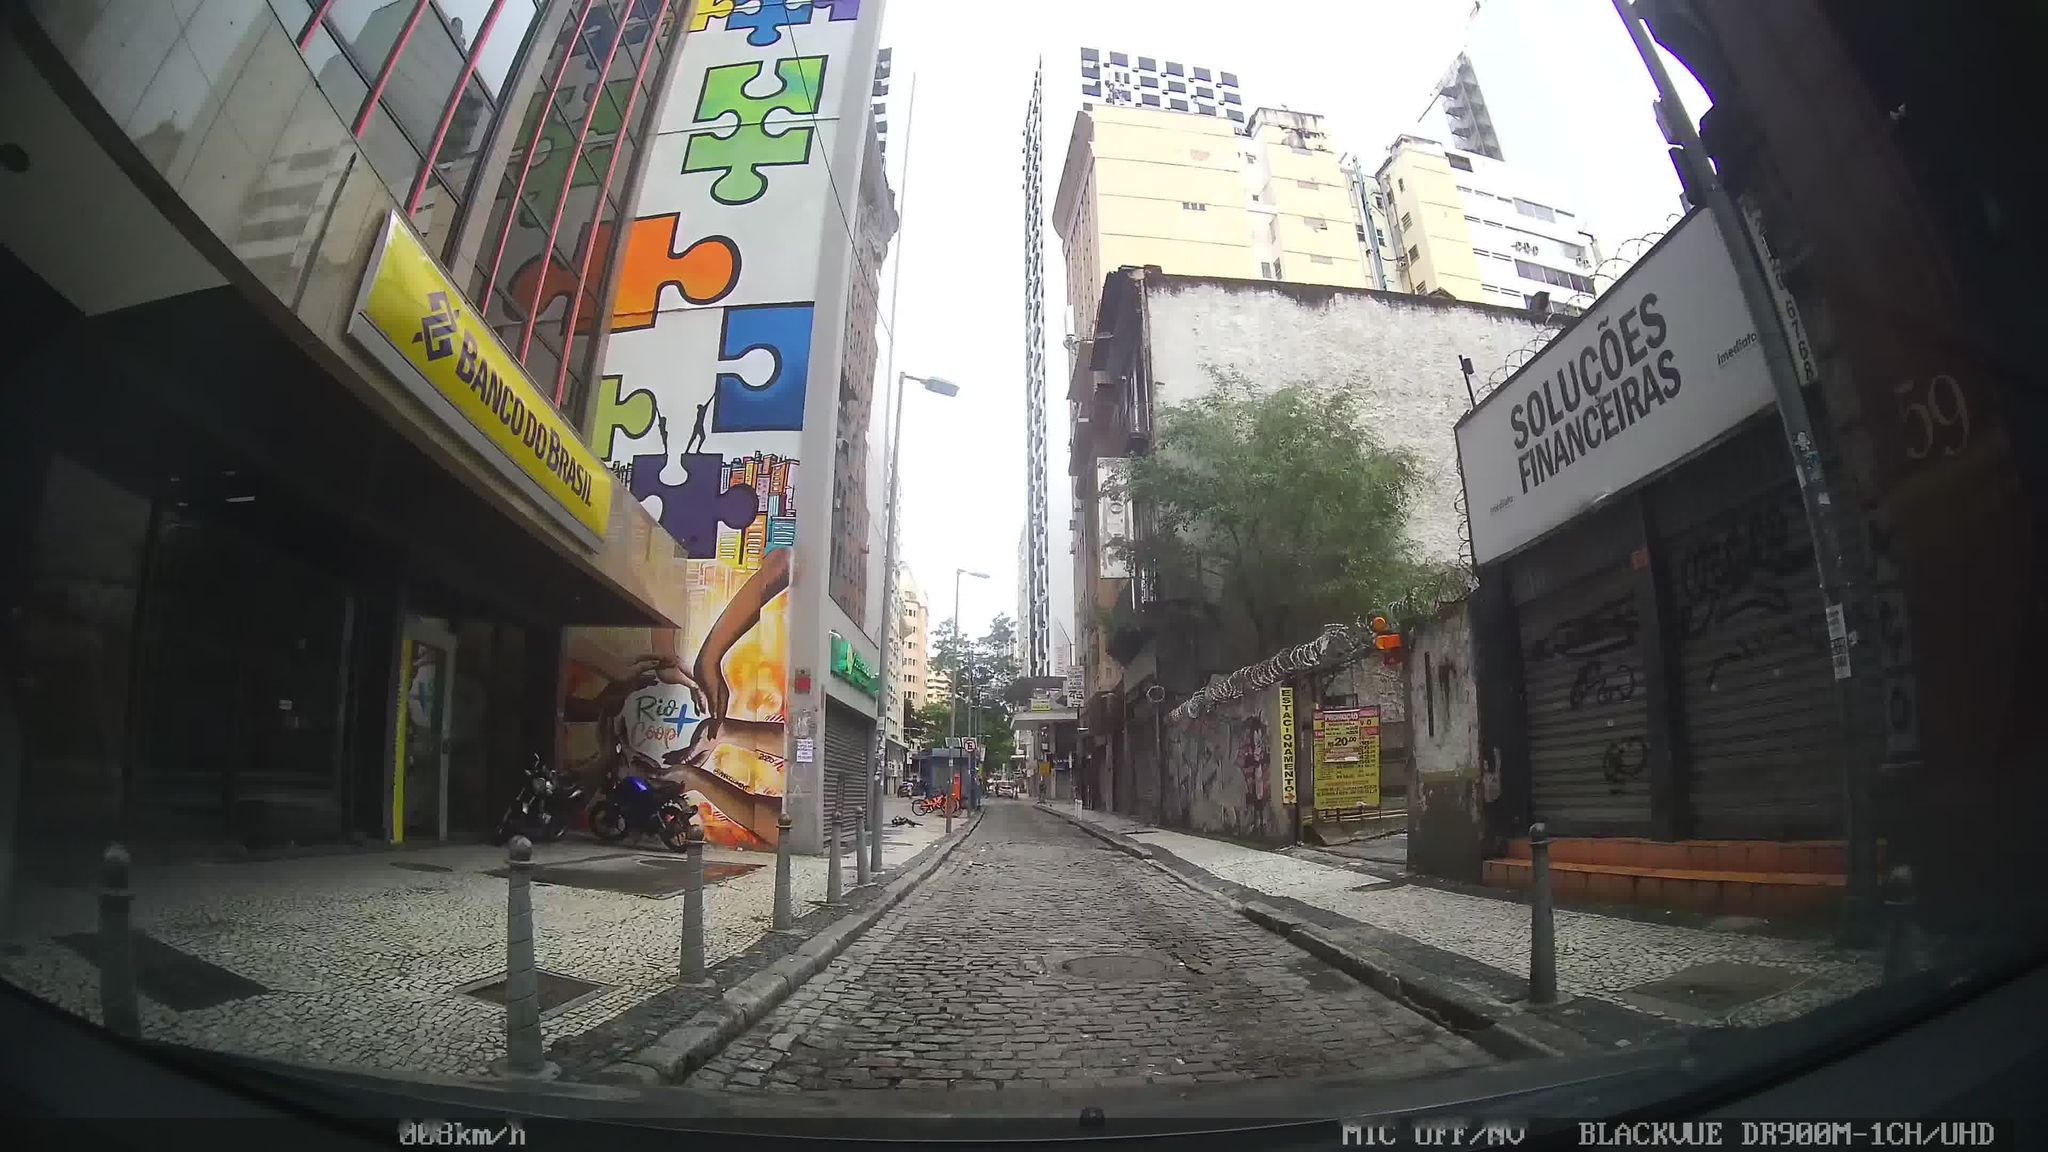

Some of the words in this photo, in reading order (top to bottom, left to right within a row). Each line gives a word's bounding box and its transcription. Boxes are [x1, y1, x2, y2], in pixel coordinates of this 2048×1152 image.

[455, 330, 525, 436] BANCO
[523, 414, 548, 460] DO
[546, 427, 593, 508] BRASIL
[1511, 292, 1667, 450] SOLUÇÕES
[1517, 349, 1682, 495] FINANCEIRAS
[634, 695, 679, 722] Rio
[1281, 689, 1295, 792] ESTACIONAMENTO
